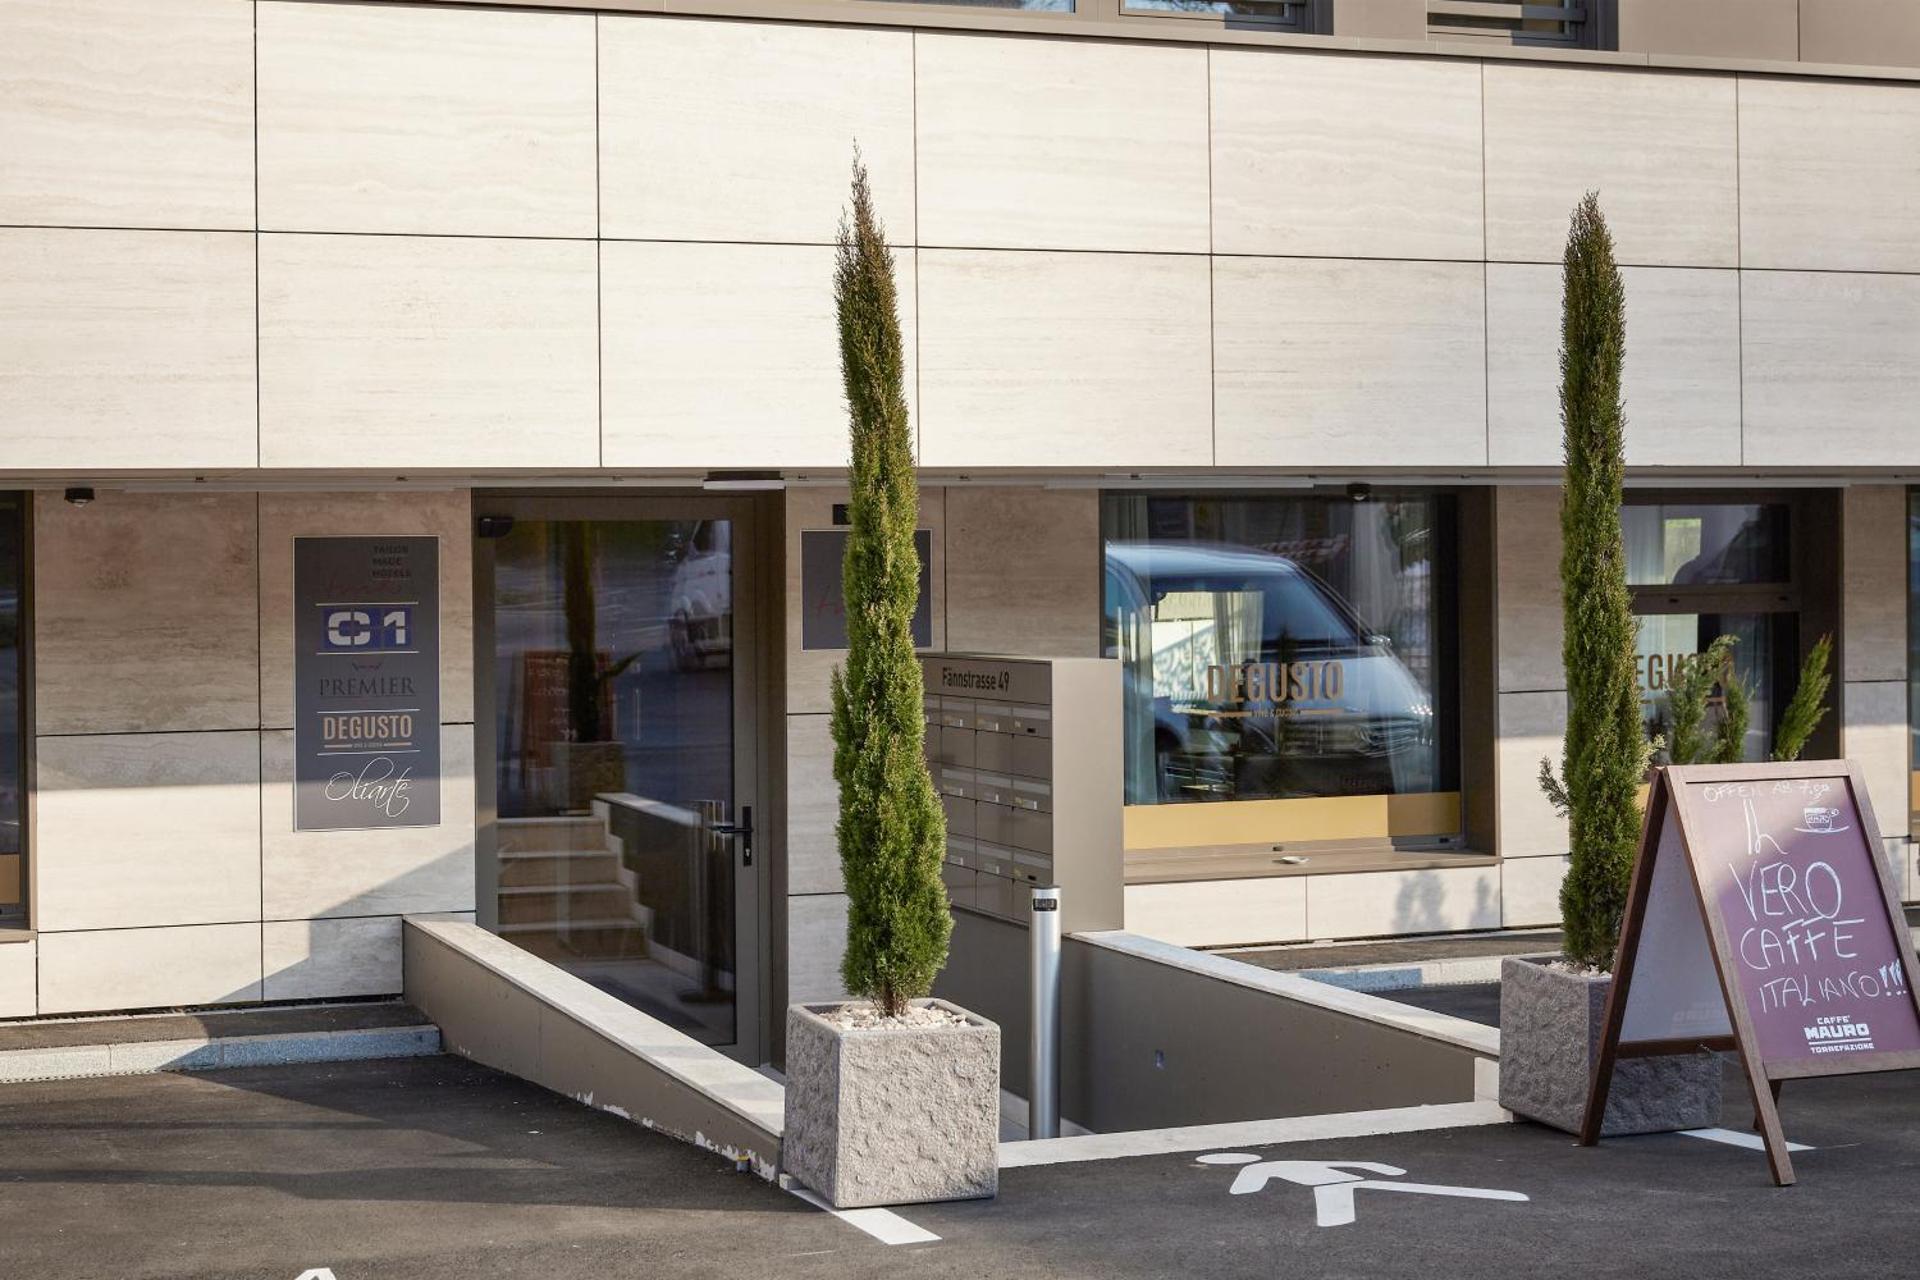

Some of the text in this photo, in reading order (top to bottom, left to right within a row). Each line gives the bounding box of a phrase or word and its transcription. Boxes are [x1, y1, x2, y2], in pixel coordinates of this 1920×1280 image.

[320, 676, 415, 697] PREMIER
[942, 666, 1011, 693] Fännstrasse 49
[1207, 661, 1345, 703] DEGUSTO
[323, 714, 412, 740] DEGUSTO
[1729, 860, 1842, 921] VERO
[1804, 1023, 1870, 1040] MAURO
[1810, 1042, 1875, 1054] TORREFAZIONE
